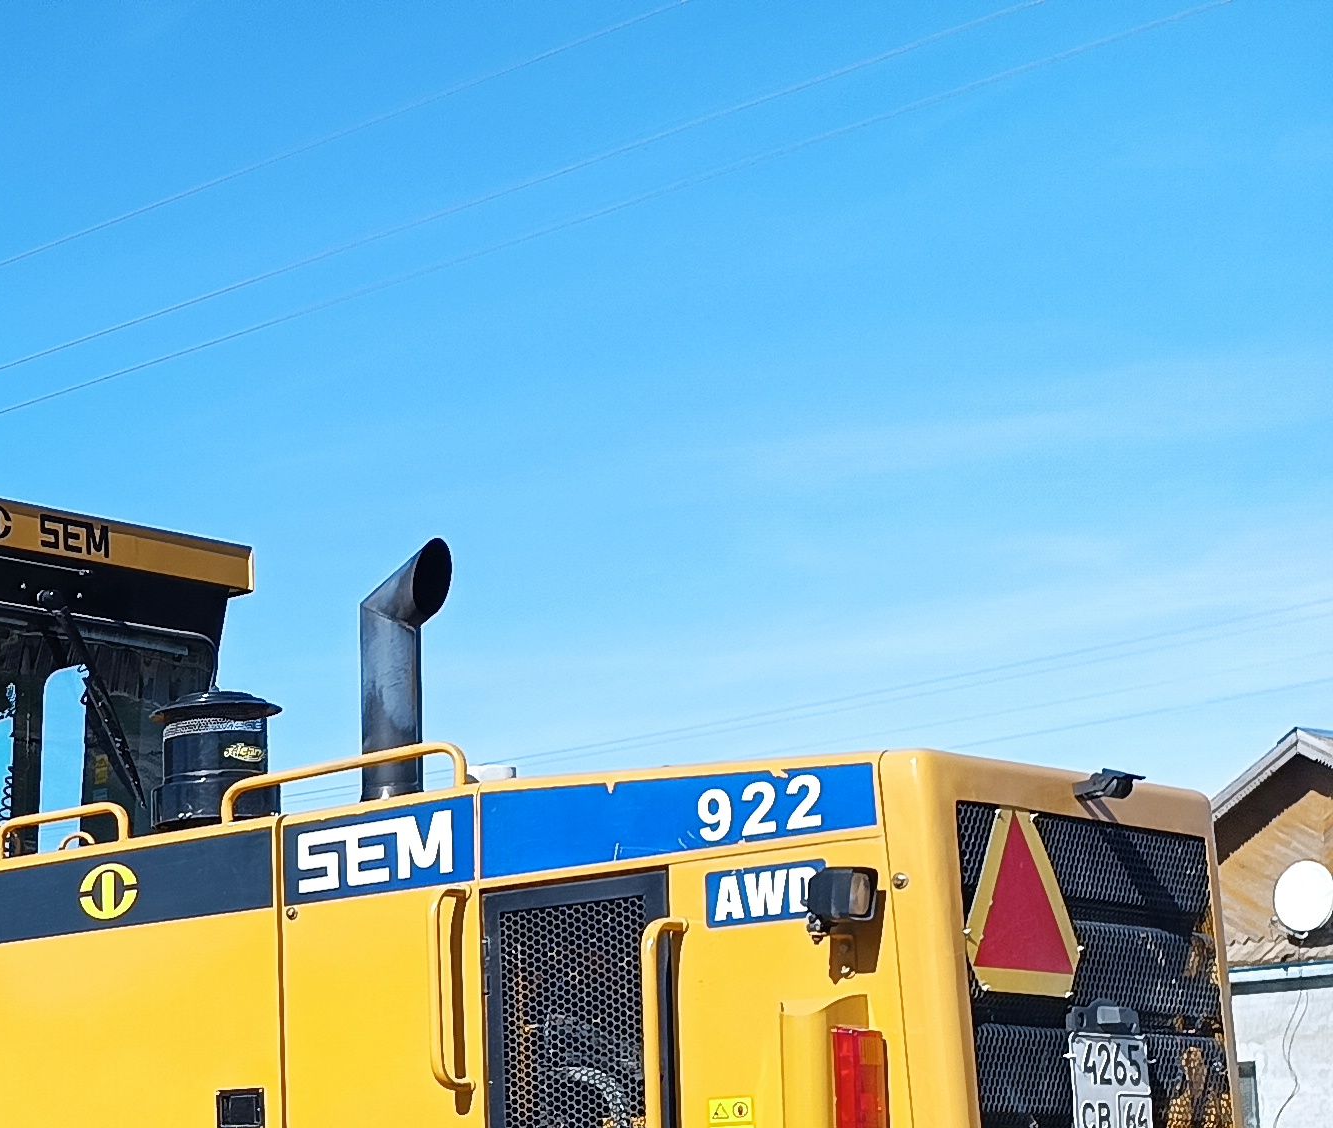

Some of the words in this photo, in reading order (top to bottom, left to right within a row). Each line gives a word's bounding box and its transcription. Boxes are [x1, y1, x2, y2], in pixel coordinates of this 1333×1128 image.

[40, 513, 110, 559] SEM
[697, 774, 822, 842] 922
[297, 809, 454, 894] SEM
[1083, 1042, 1142, 1087] 4265
